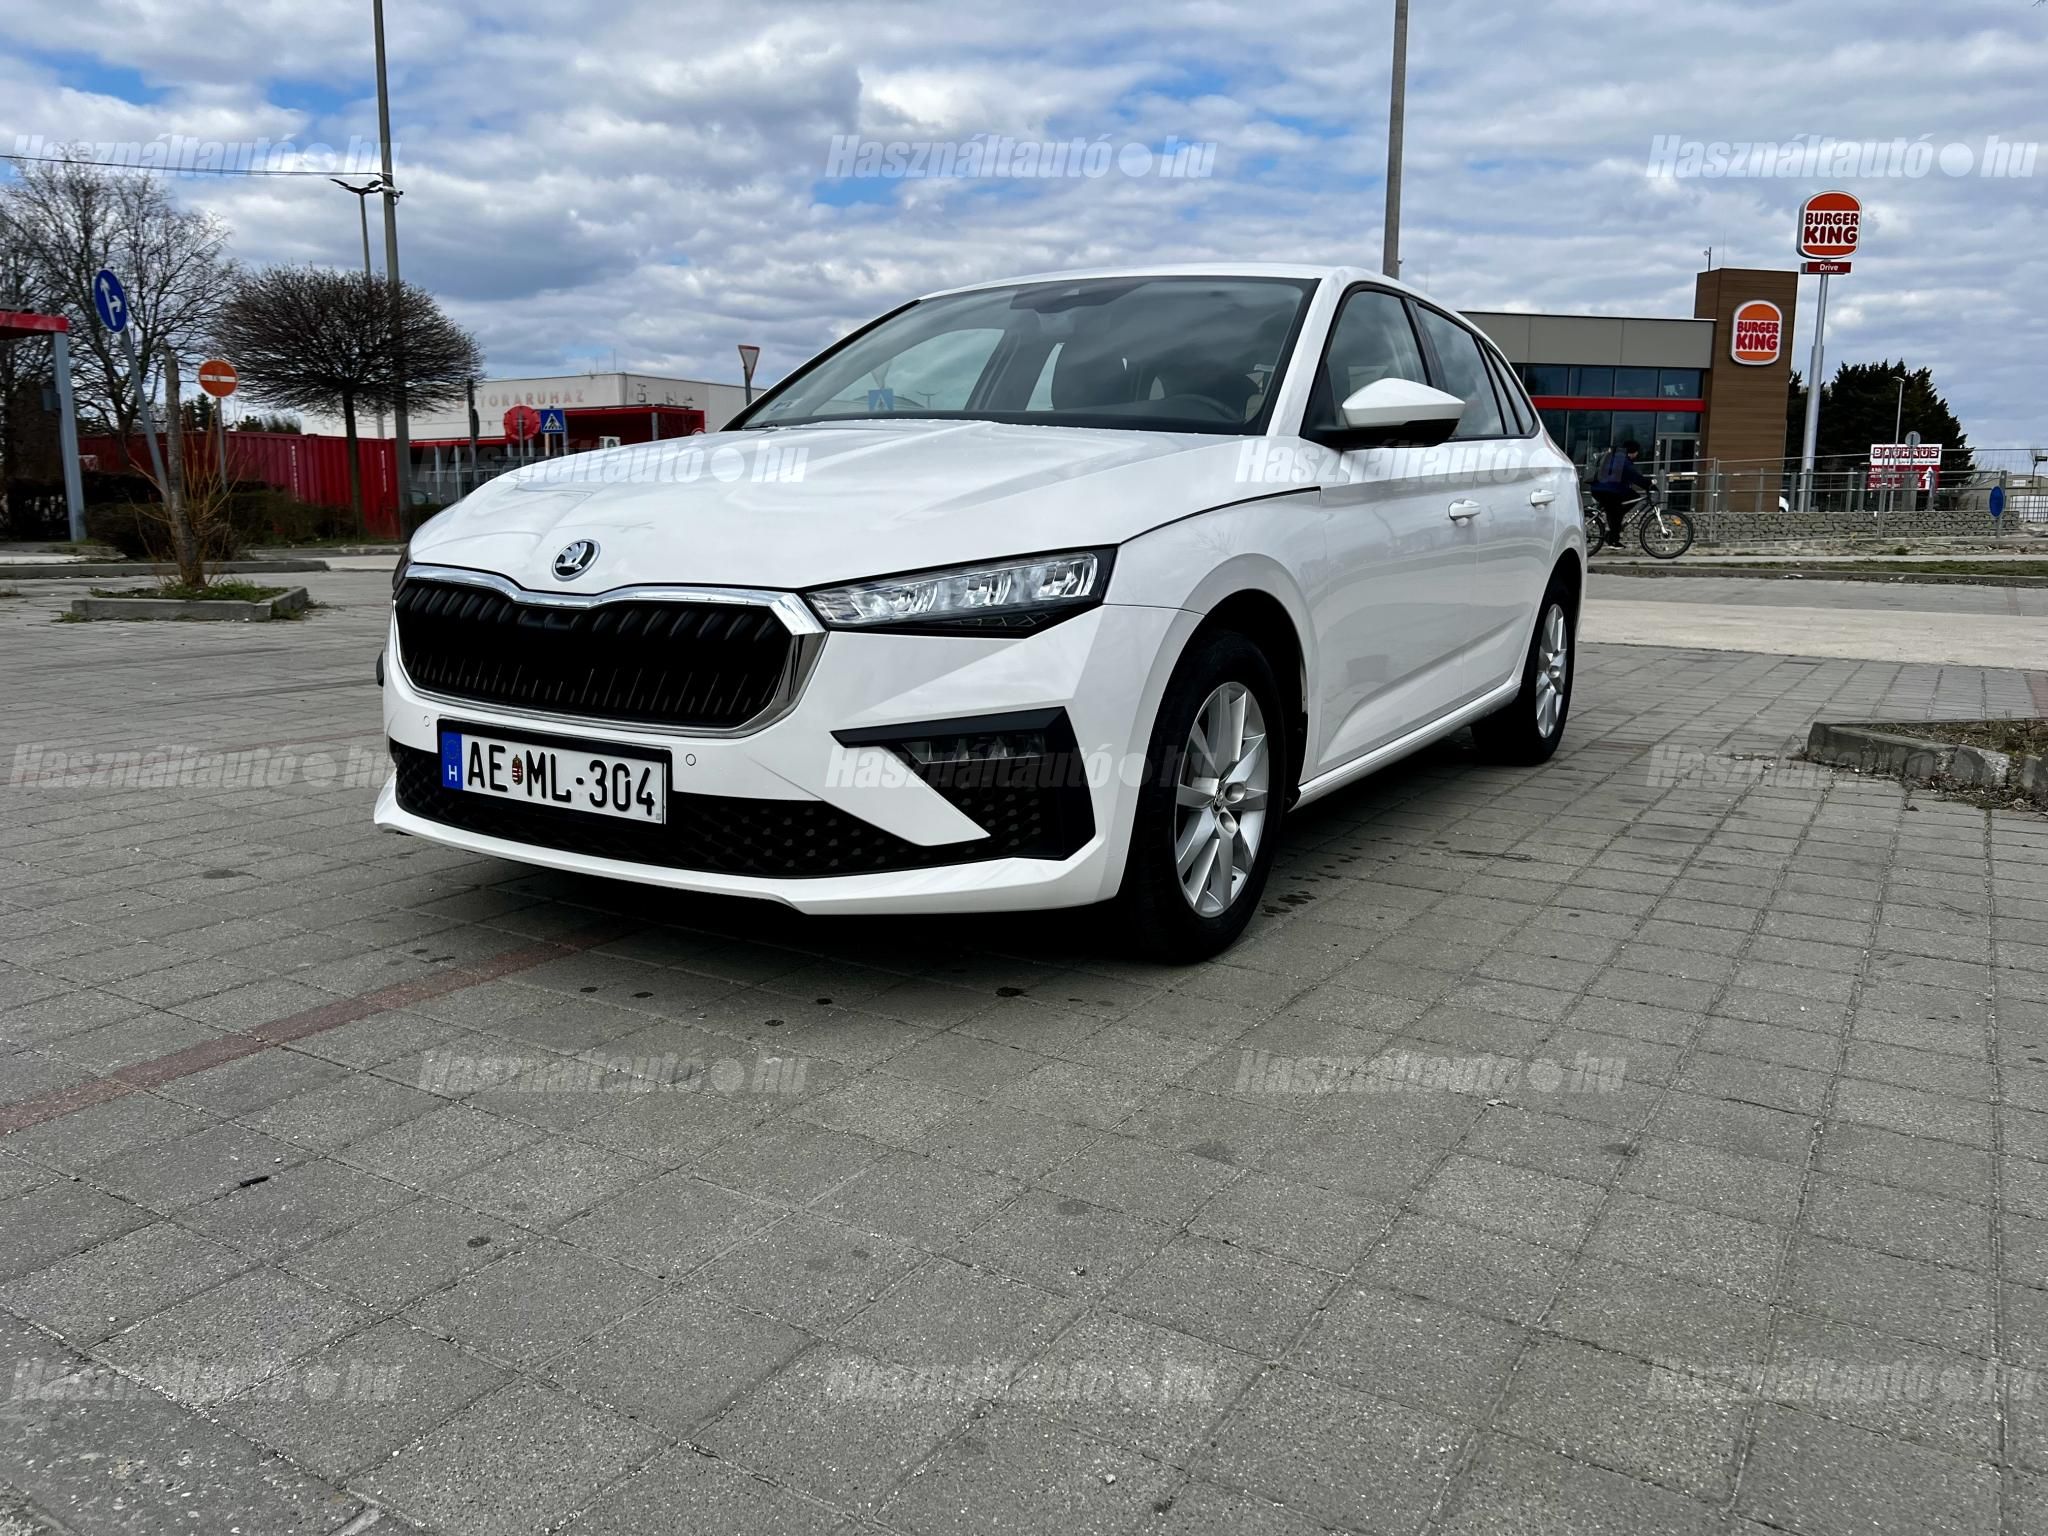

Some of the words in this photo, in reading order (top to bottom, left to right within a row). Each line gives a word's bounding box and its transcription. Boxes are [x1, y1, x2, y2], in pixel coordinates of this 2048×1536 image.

[1805, 212, 1859, 225] BURGER
[1804, 226, 1858, 244] KING
[1737, 321, 1779, 334] BURGER
[1735, 334, 1778, 350] KING
[1873, 447, 1939, 458] BAUHAUS
[448, 764, 458, 782] H
